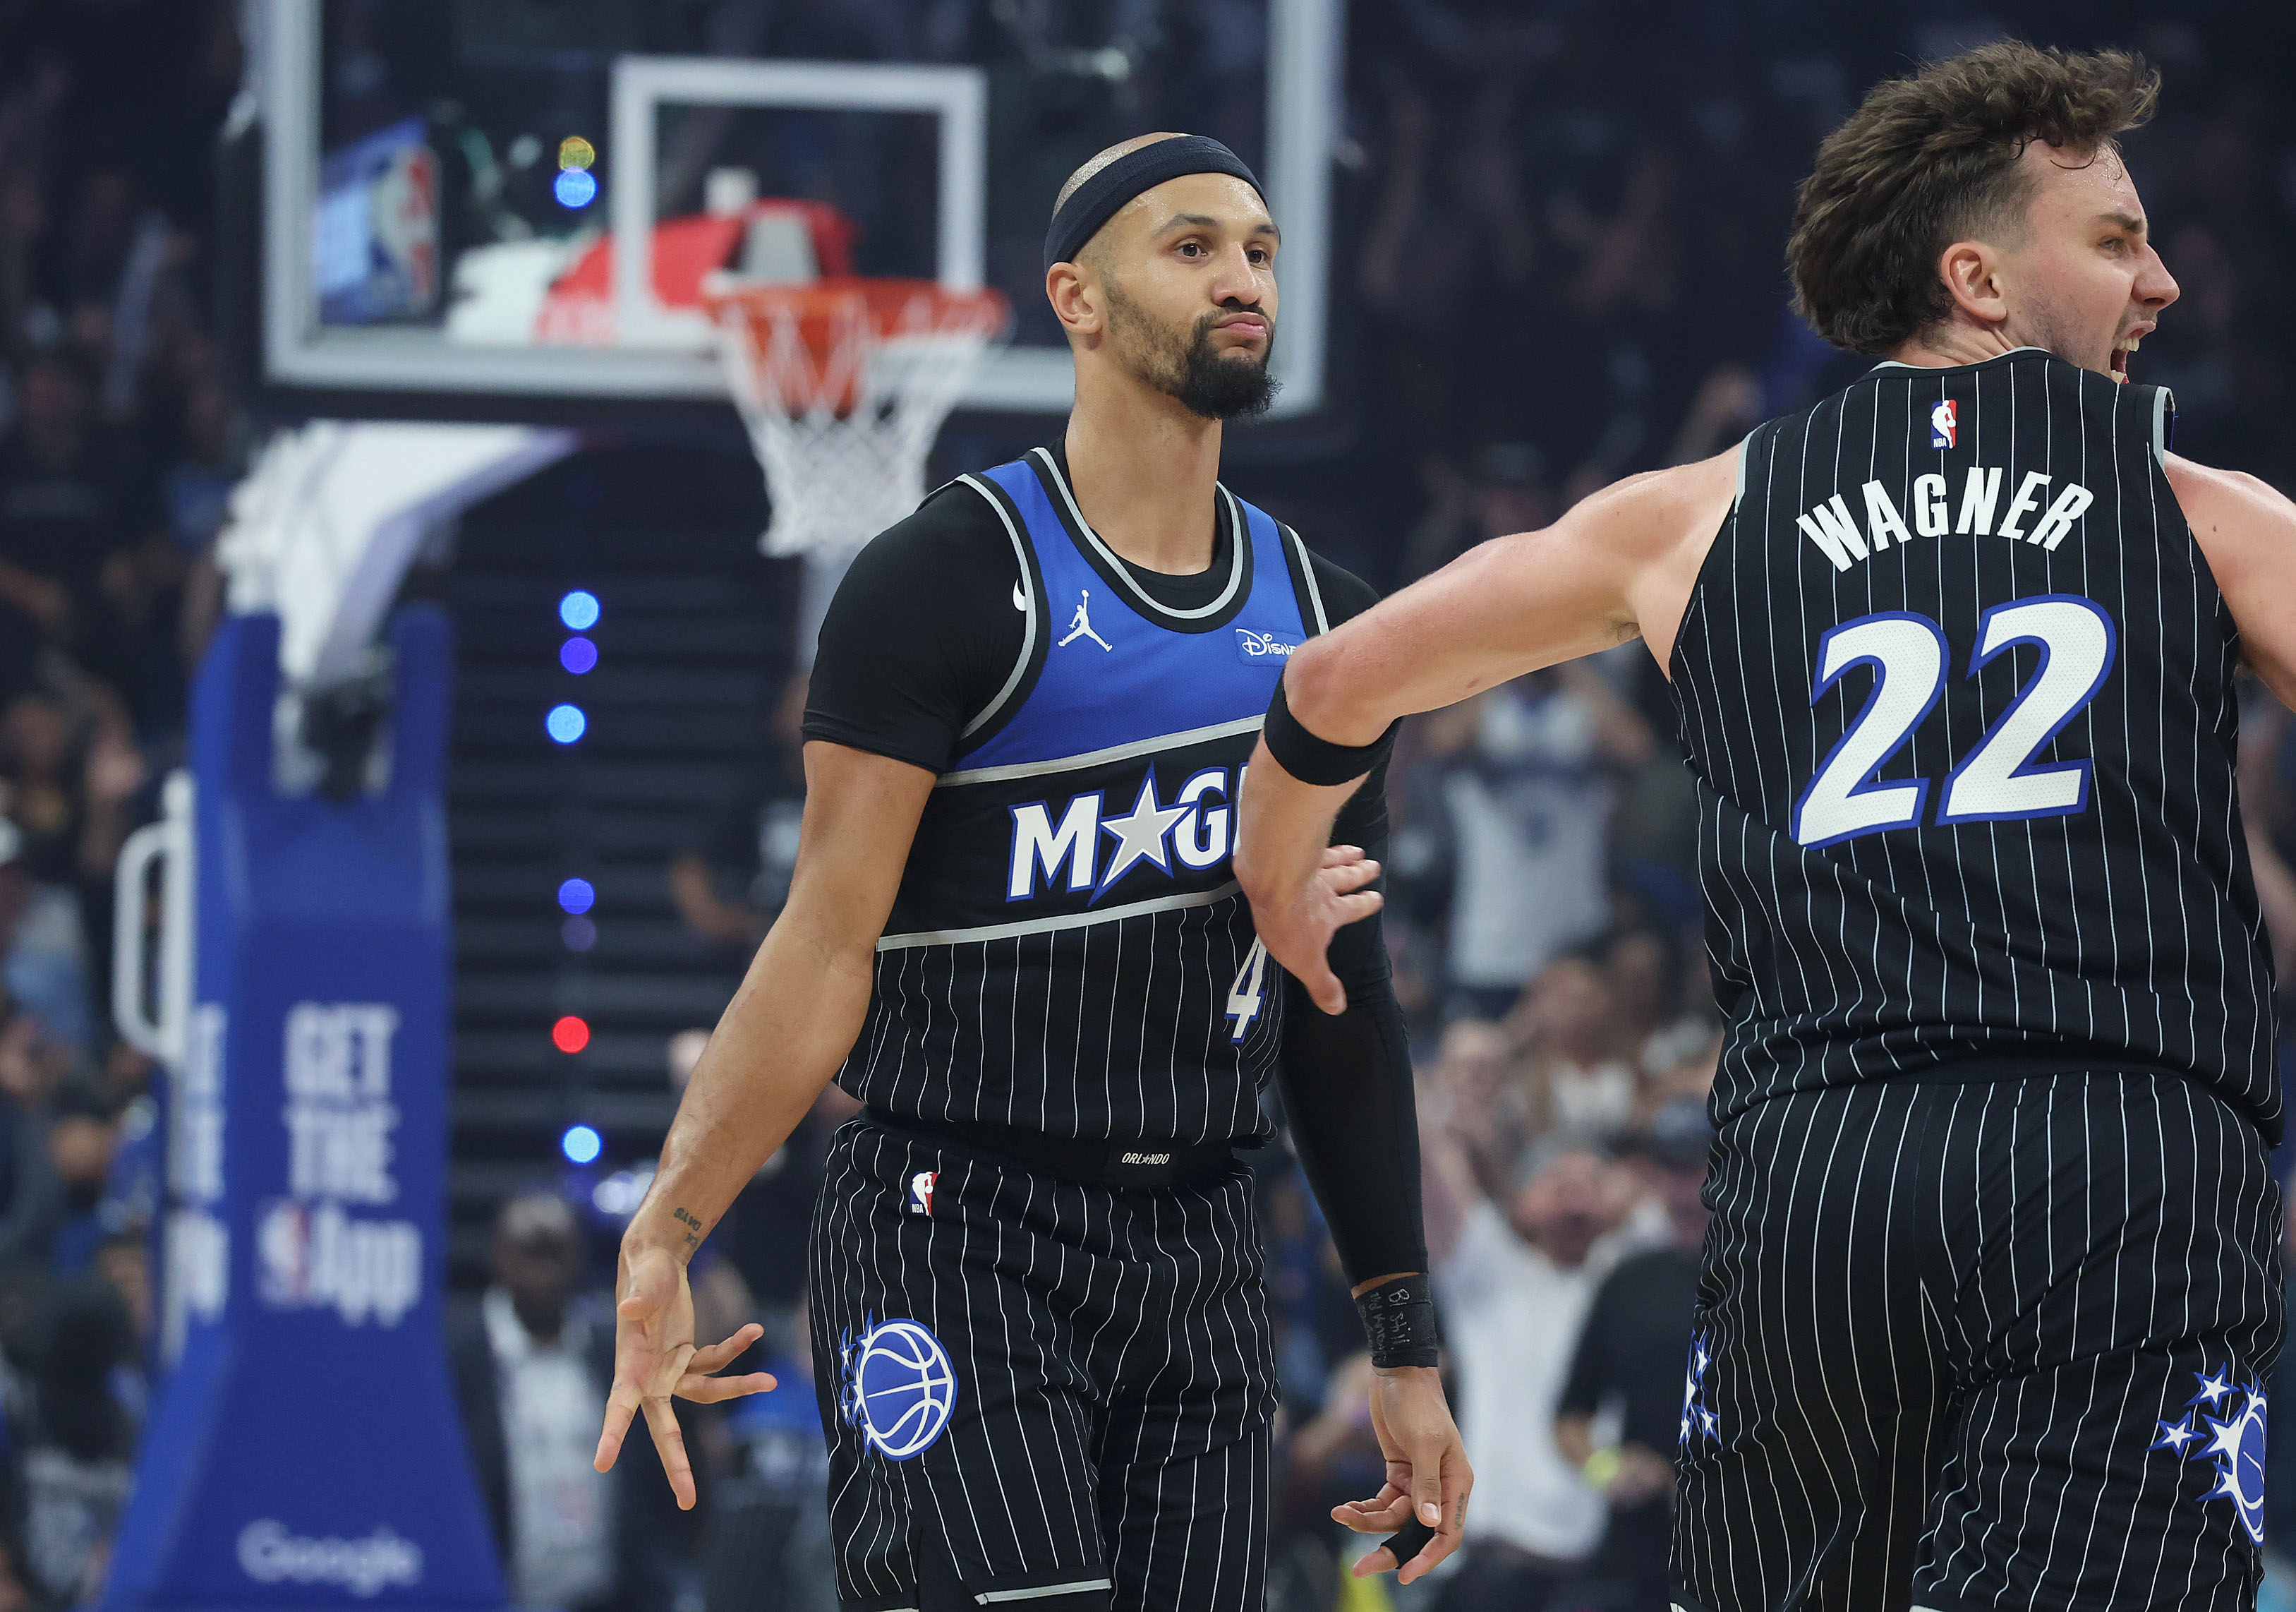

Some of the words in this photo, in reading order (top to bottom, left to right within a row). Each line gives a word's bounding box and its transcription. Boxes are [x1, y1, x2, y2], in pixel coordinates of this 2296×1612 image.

[1933, 438, 1947, 448] NBA
[1796, 467, 2093, 572] WAGNER
[1235, 628, 1298, 656] Disne
[1790, 593, 2117, 850] 22
[1224, 933, 1267, 1044] 4
[284, 1002, 399, 1096] GET
[283, 1102, 399, 1203] THE
[912, 1203, 924, 1214] NBA
[314, 1203, 423, 1328] App
[237, 1519, 424, 1599] Google
